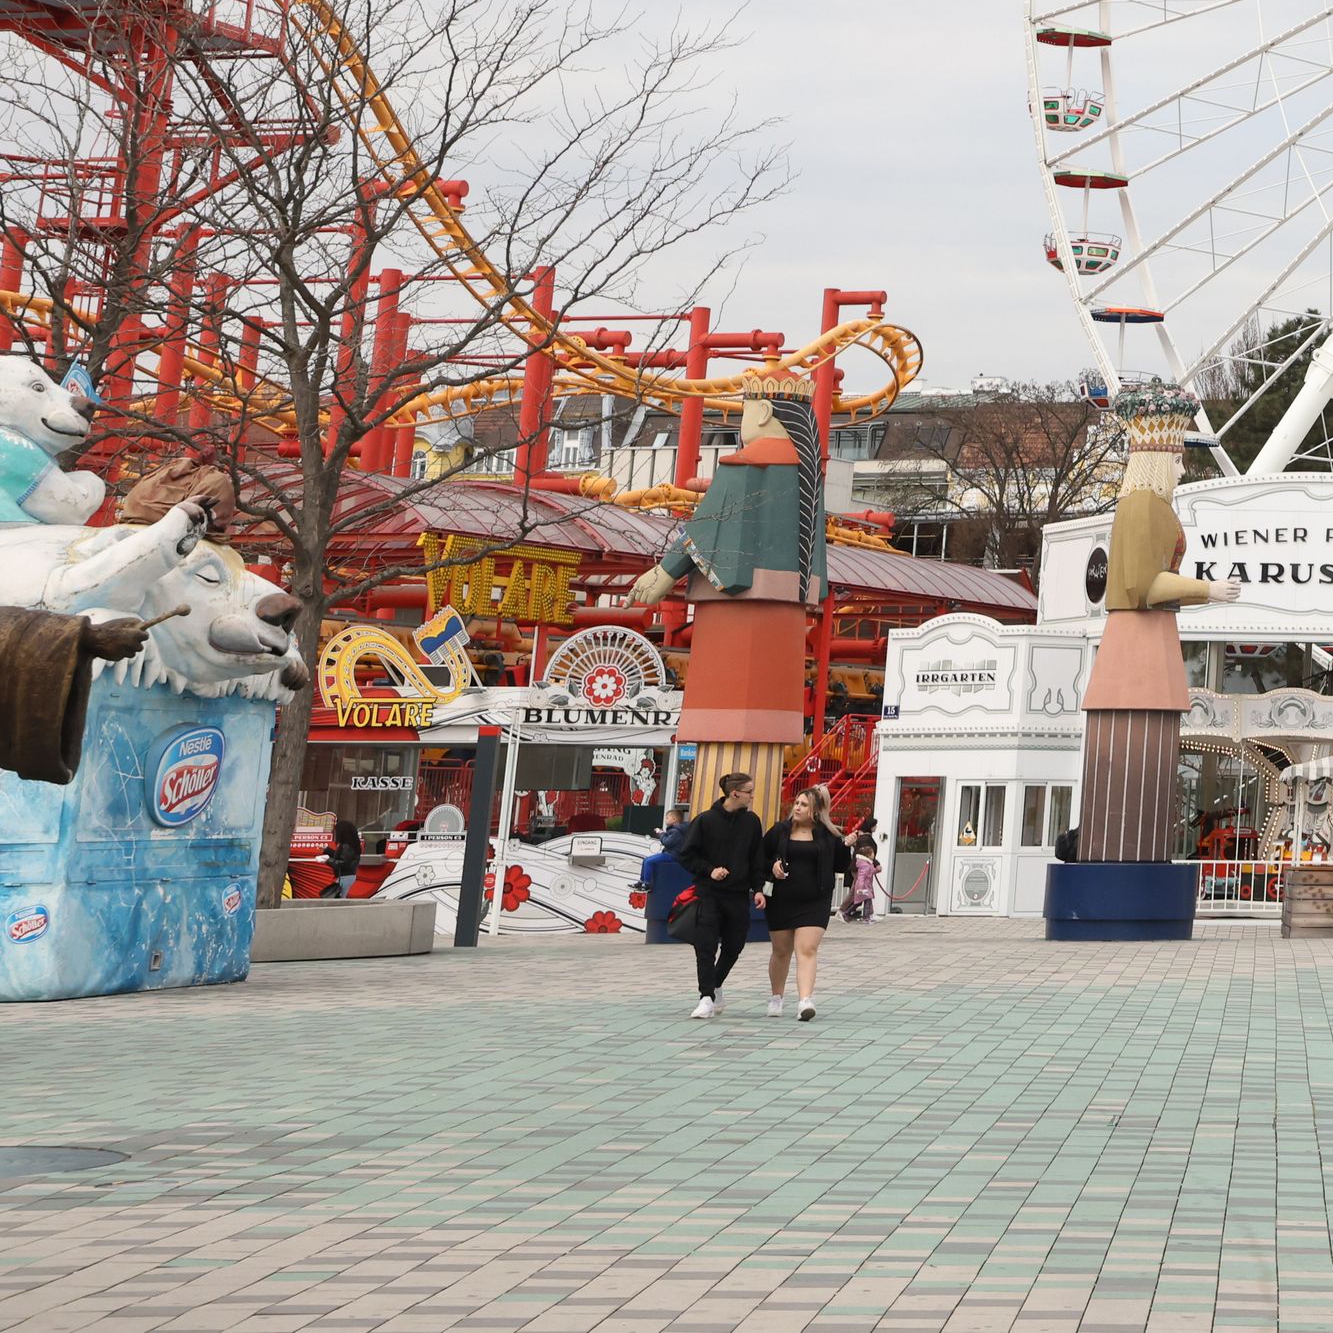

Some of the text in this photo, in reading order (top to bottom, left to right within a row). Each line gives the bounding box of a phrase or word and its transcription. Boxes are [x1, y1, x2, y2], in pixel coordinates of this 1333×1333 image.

[1200, 527, 1308, 548] WIENER
[416, 532, 582, 625] VOLARE
[916, 672, 996, 684] IRRGARTEN
[333, 697, 438, 728] VOLARE
[523, 708, 681, 726] BLUMENR
[886, 706, 896, 715] 15
[179, 734, 213, 757] Nestlé
[160, 764, 218, 811] Schöller
[351, 776, 414, 790] KASSE
